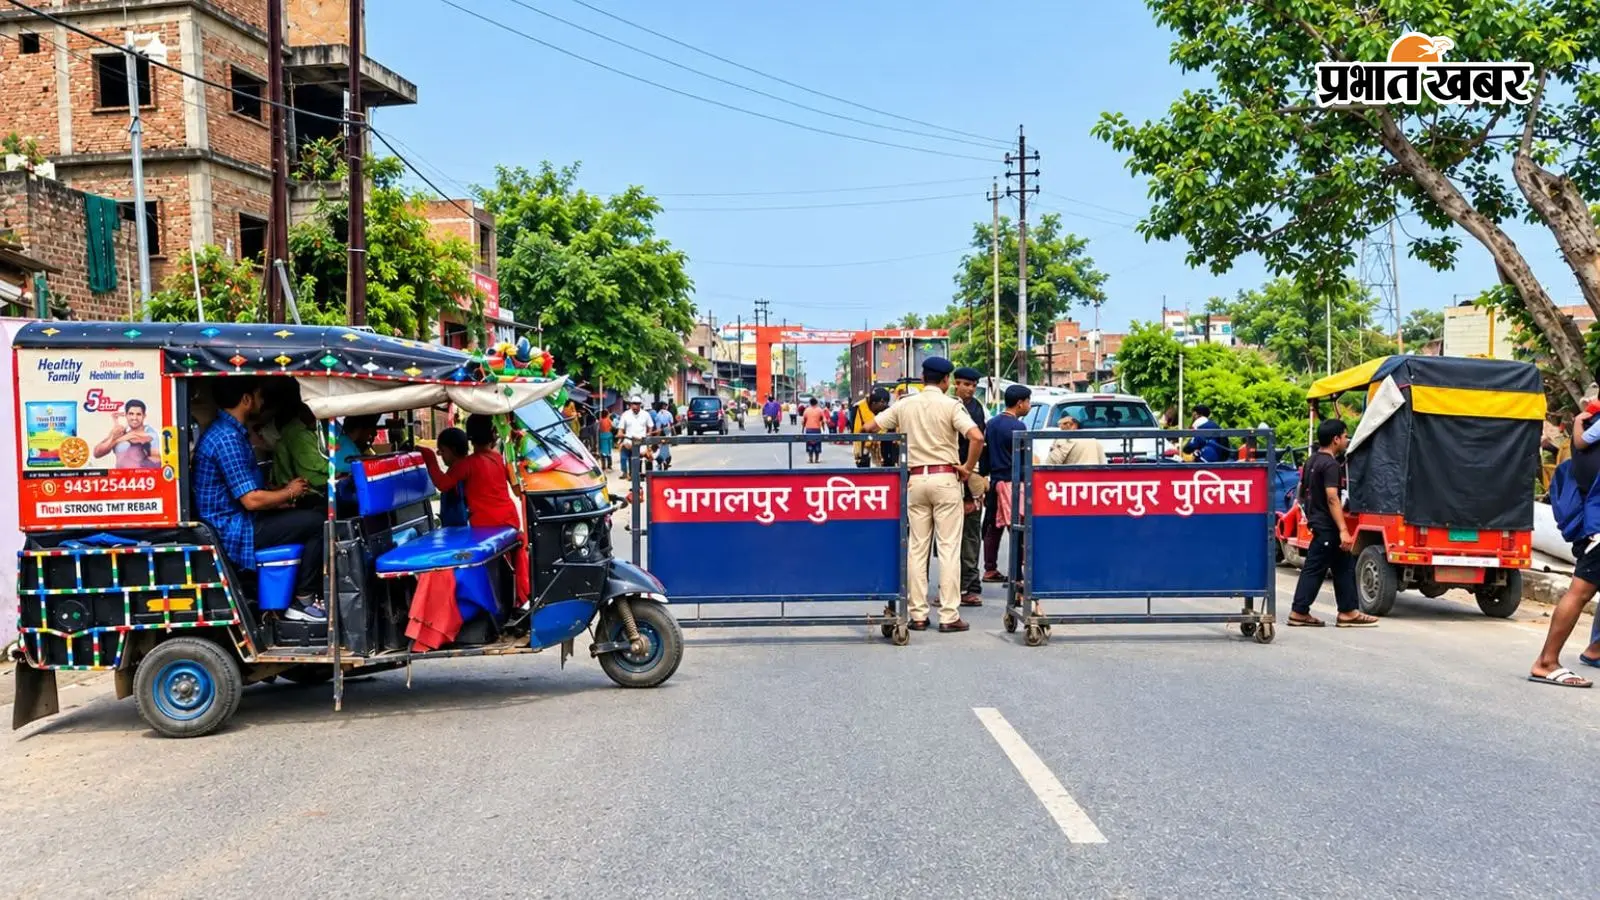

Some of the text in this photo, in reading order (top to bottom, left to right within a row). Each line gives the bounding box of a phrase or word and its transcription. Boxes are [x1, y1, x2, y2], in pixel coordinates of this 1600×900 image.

[38, 358, 83, 373] Healthy
[47, 371, 80, 384] Family
[123, 370, 144, 380] India
[63, 477, 156, 494] 9431254449
[1045, 470, 1253, 516] भागलपुर पुलिस
[663, 476, 890, 523] भागलपुर पुलिस
[64, 503, 103, 514] STRONG
[106, 503, 125, 512] TMT
[127, 501, 158, 512] REBAR
